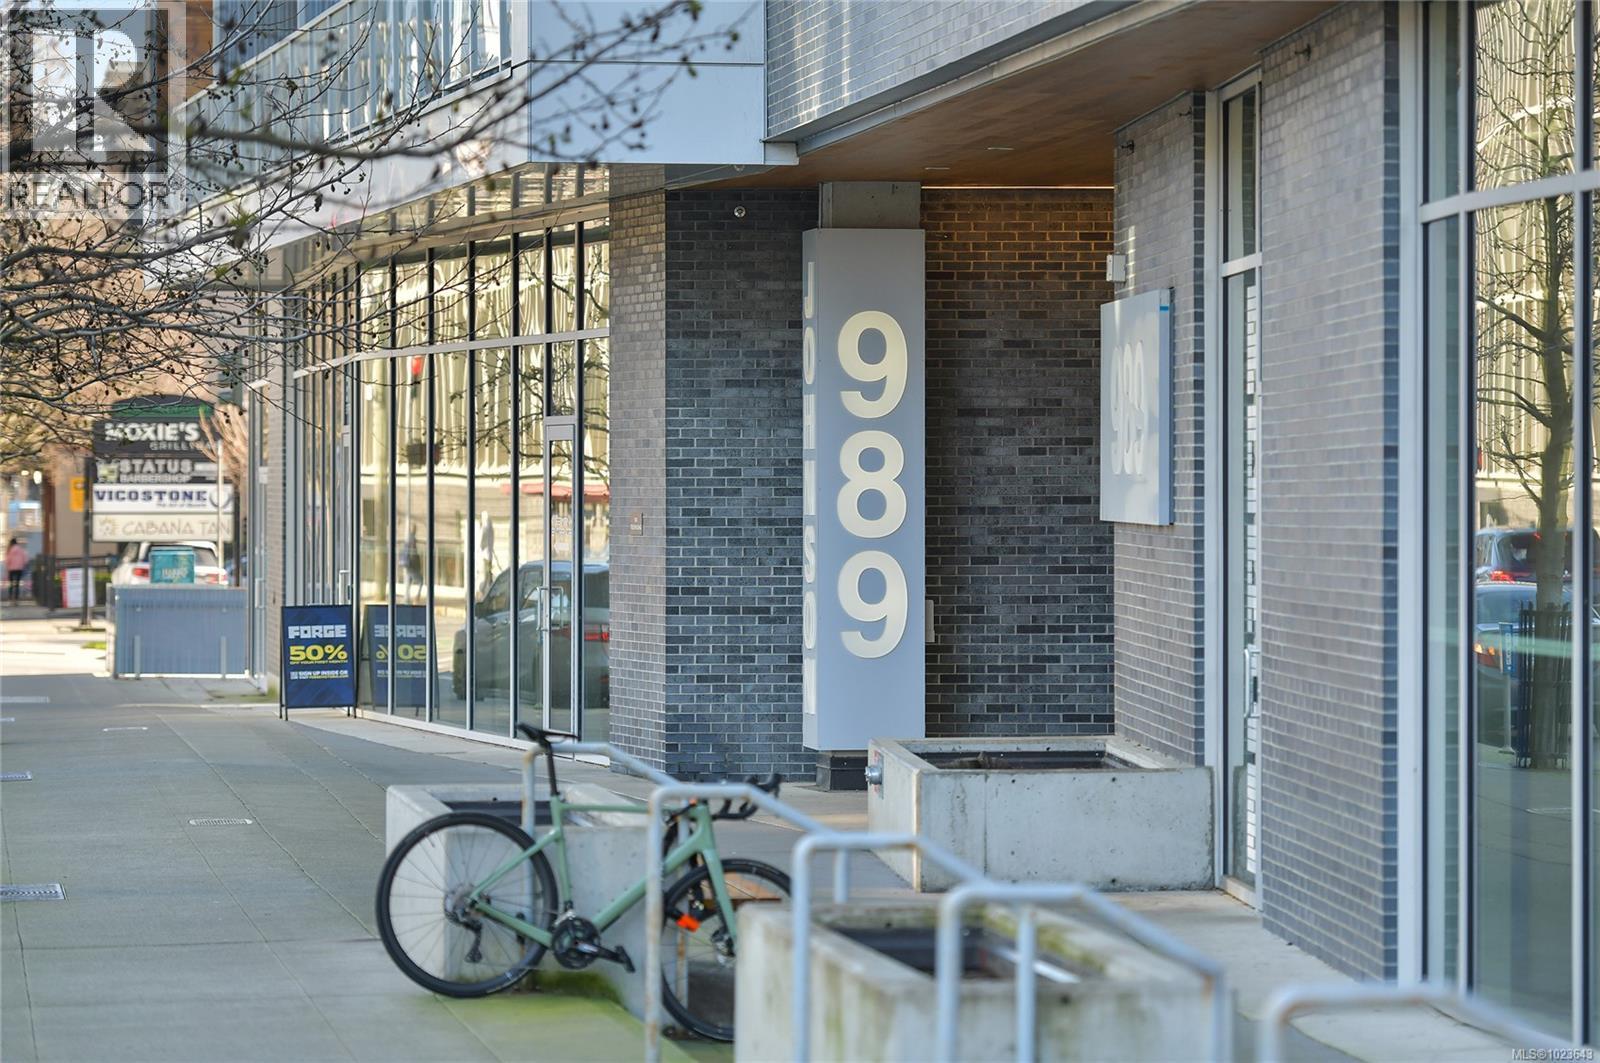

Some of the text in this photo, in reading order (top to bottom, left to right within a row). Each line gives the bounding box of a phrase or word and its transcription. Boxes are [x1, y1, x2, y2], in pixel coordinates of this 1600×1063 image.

[120, 459, 192, 474] STATUS
[837, 310, 908, 659] 989
[94, 490, 207, 501] VICOSTONE
[122, 521, 194, 535] CABANA
[288, 625, 347, 638] FORGE
[290, 644, 347, 660] 50%
